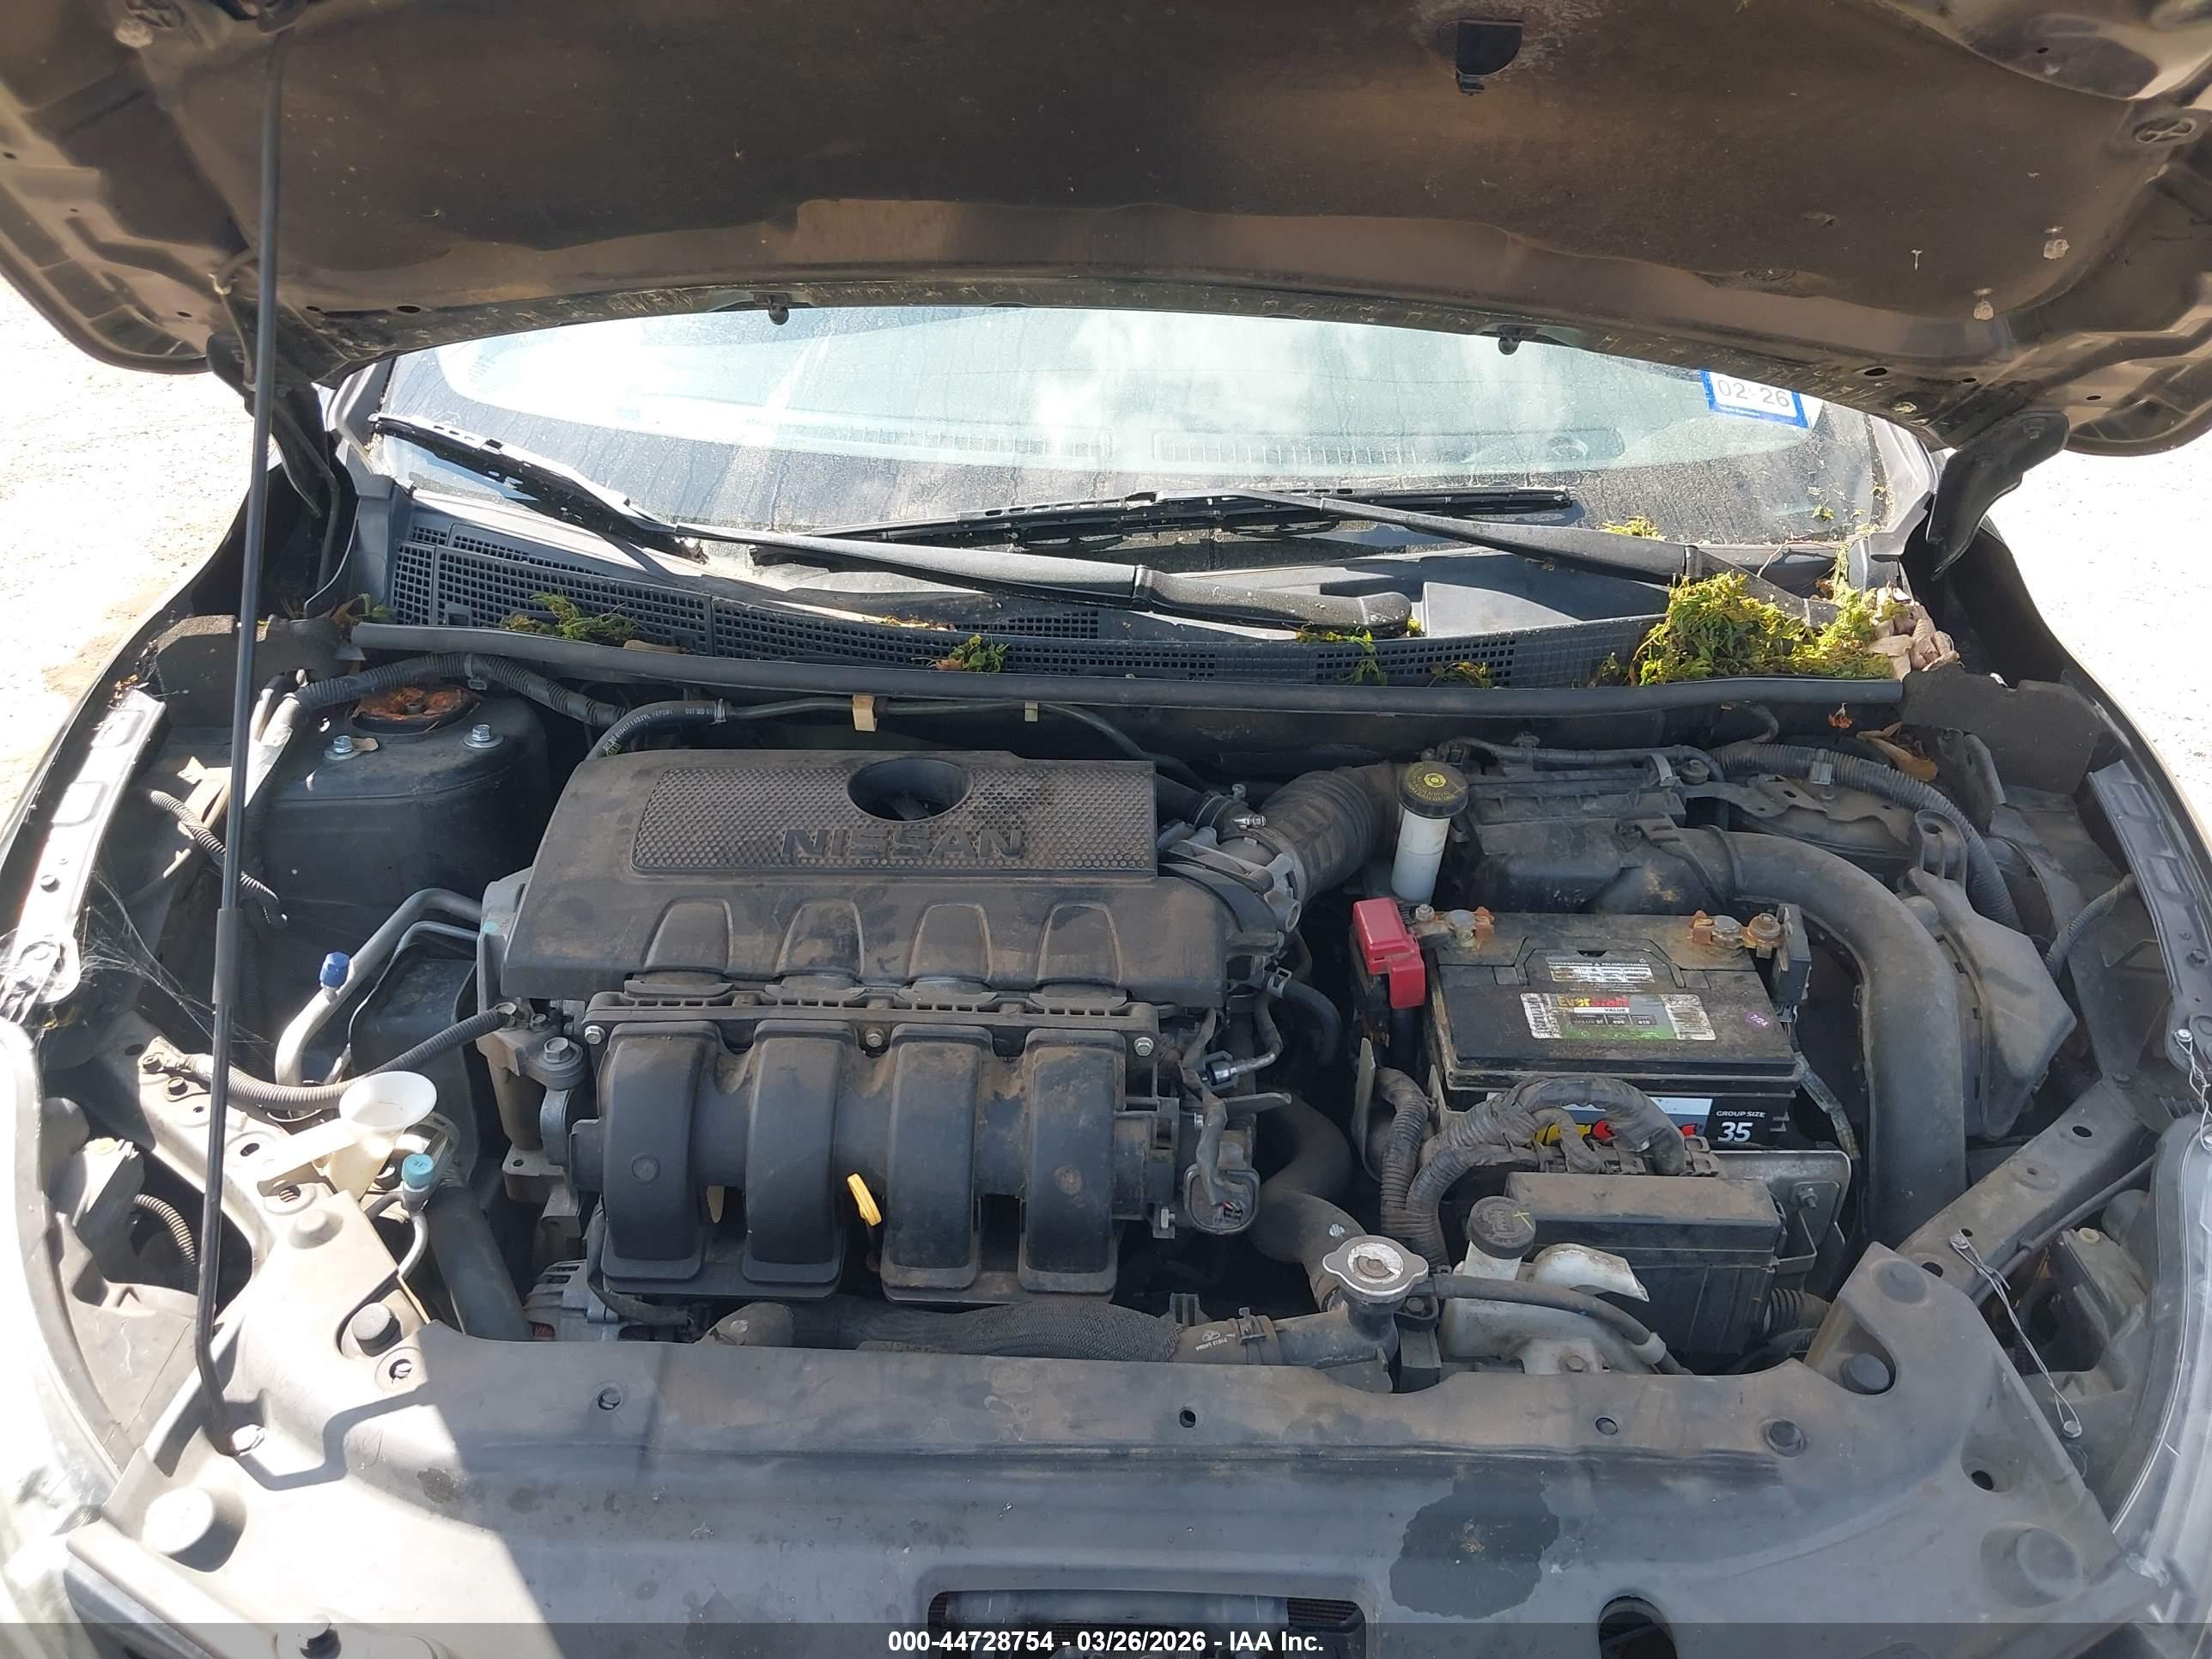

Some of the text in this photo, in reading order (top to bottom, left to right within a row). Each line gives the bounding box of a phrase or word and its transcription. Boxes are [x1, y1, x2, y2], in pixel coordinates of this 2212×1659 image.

[780, 828, 1024, 859] NISSAN
[1746, 1110, 1767, 1119] SIZE
[1717, 1121, 1754, 1143] 35
